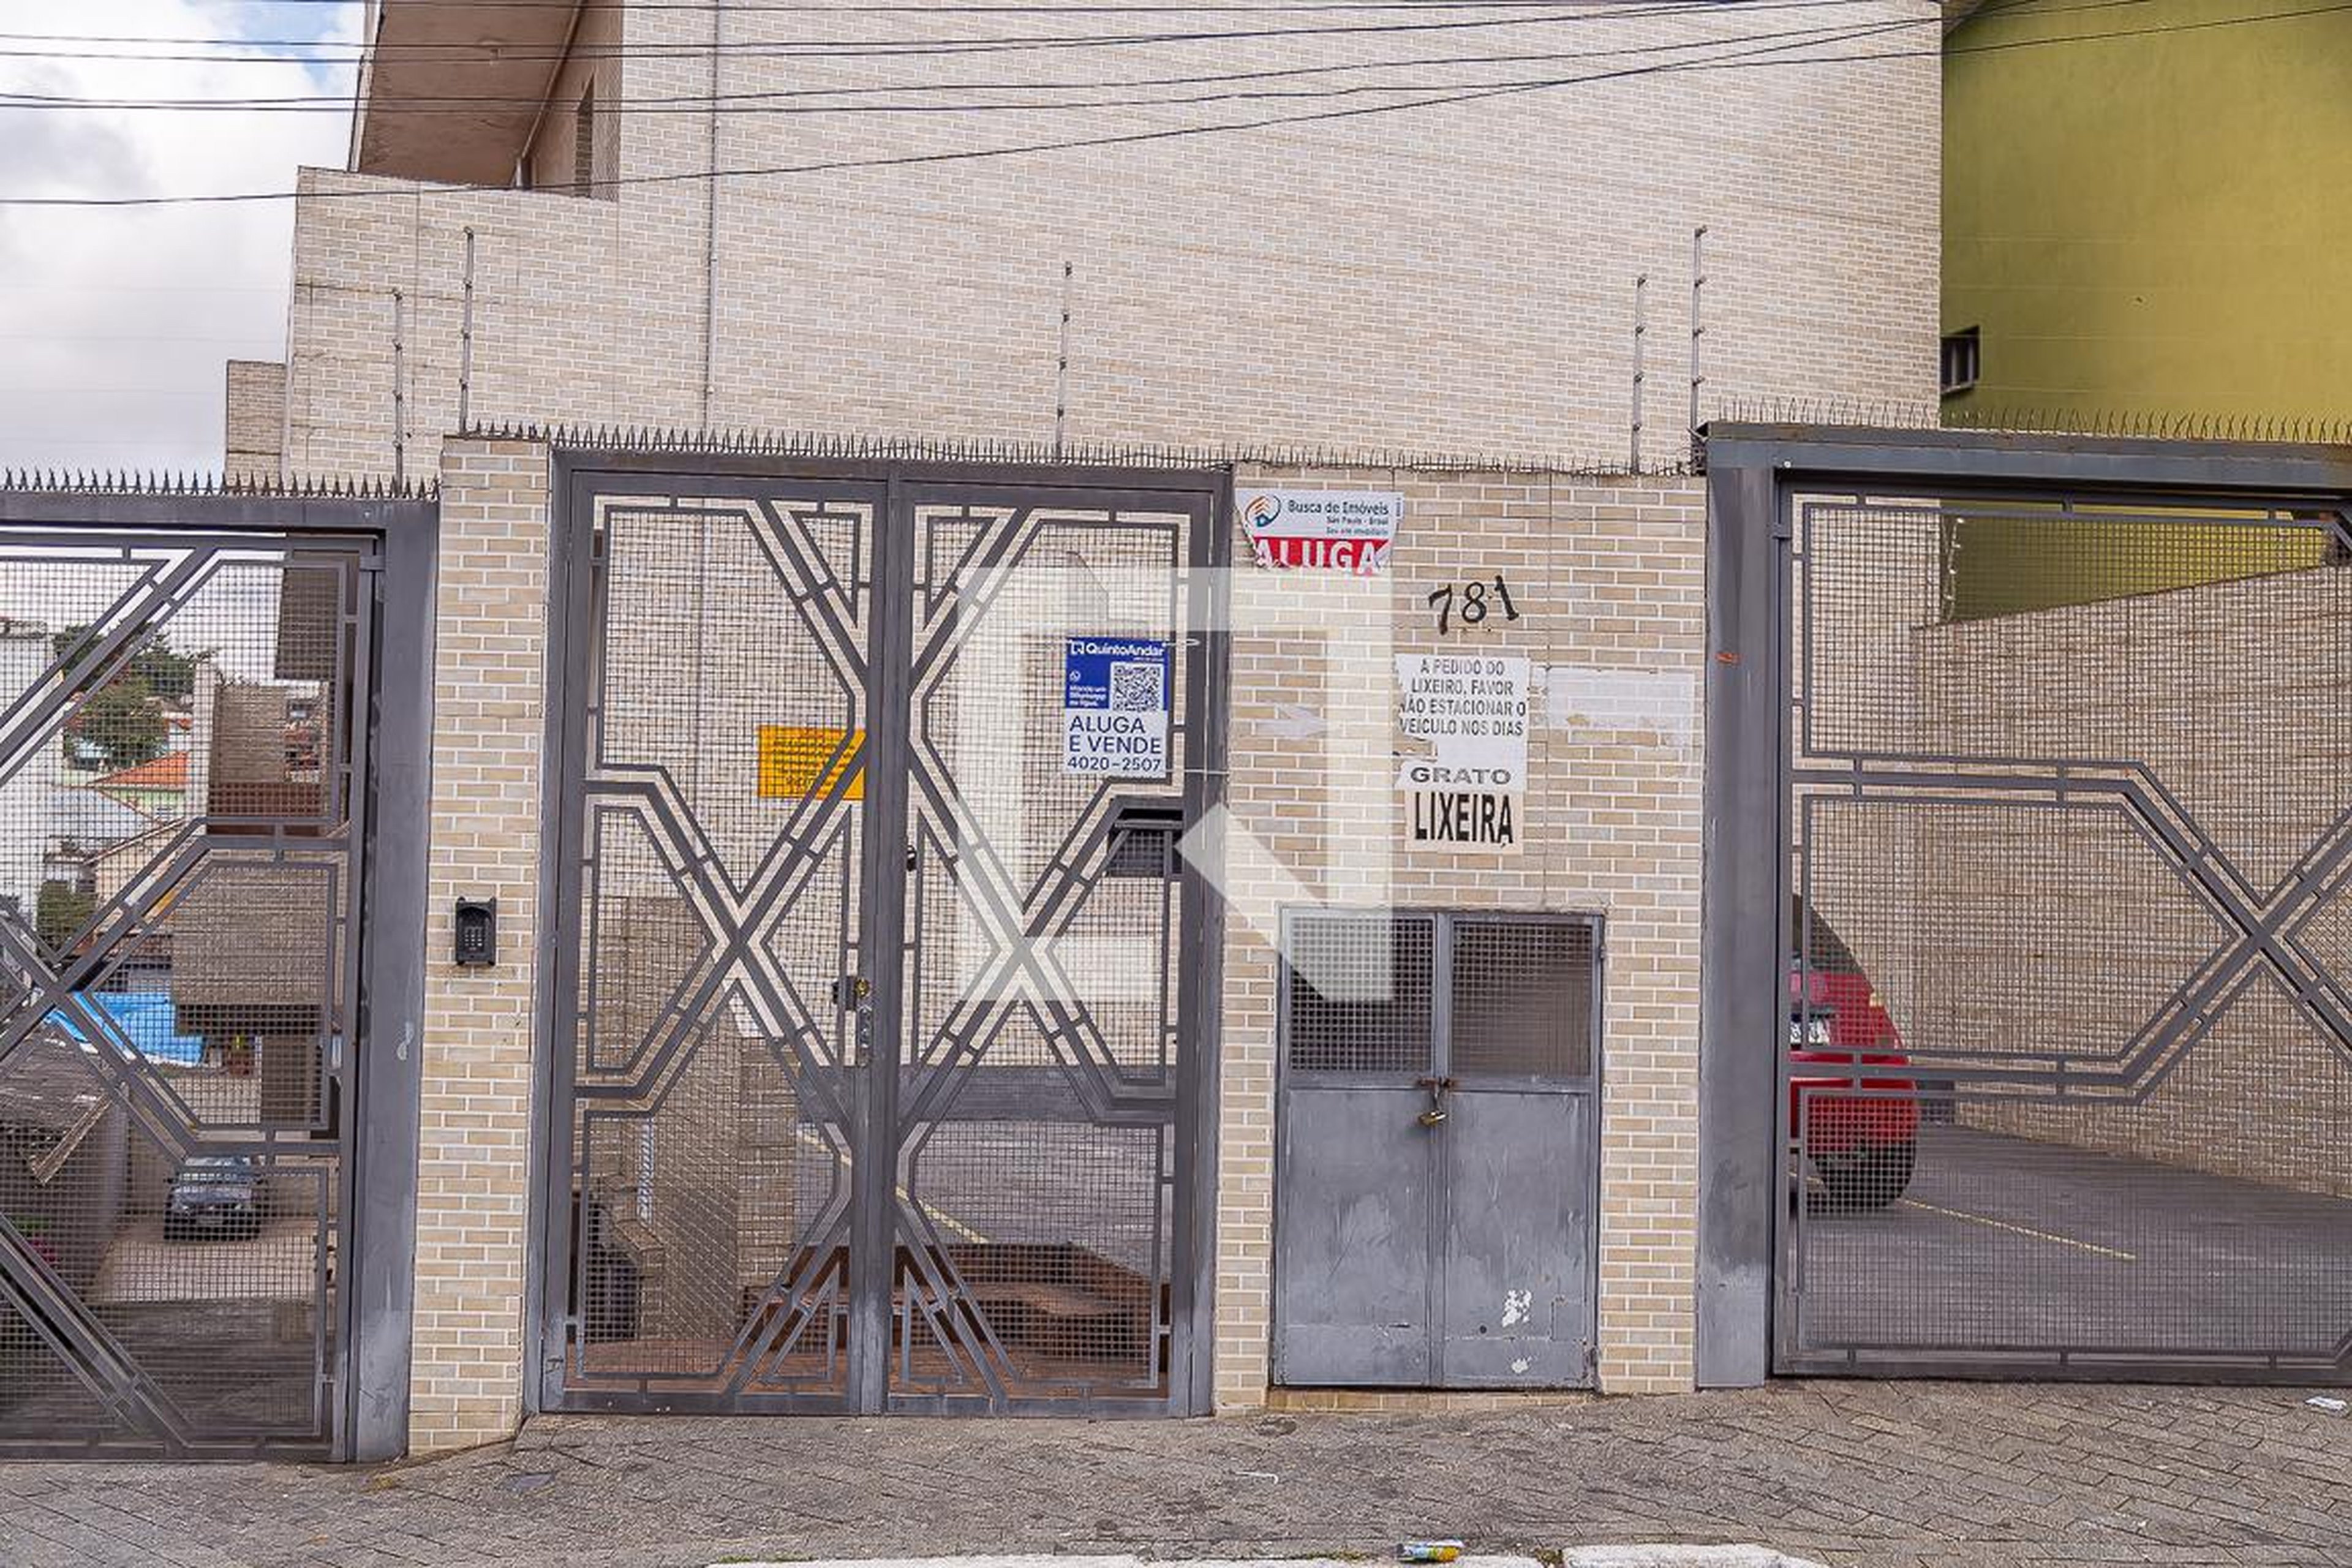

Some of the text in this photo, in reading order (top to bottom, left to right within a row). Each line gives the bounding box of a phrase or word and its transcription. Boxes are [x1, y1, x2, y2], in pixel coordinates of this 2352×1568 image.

[1288, 500, 1321, 513] Busca
[1326, 501, 1340, 513] de
[1343, 501, 1389, 514] Imóveis
[1428, 575, 1519, 635] 781
[1085, 643, 1163, 656] QuintoAndar
[1420, 658, 1505, 676] A PEDIDO DO
[1411, 678, 1513, 696] LIXEIRO, FAVOR
[1430, 698, 1513, 717] ESTACIONAR
[1517, 701, 1526, 717] O
[1069, 715, 1145, 734] ALUGA
[1461, 720, 1489, 736] NOS
[1493, 720, 1524, 736] DIAS
[1069, 734, 1163, 755] E VENDE
[1068, 756, 1161, 772] 4020-2507
[1411, 767, 1511, 785] GRATO
[1414, 791, 1513, 845] LIXEIRA
